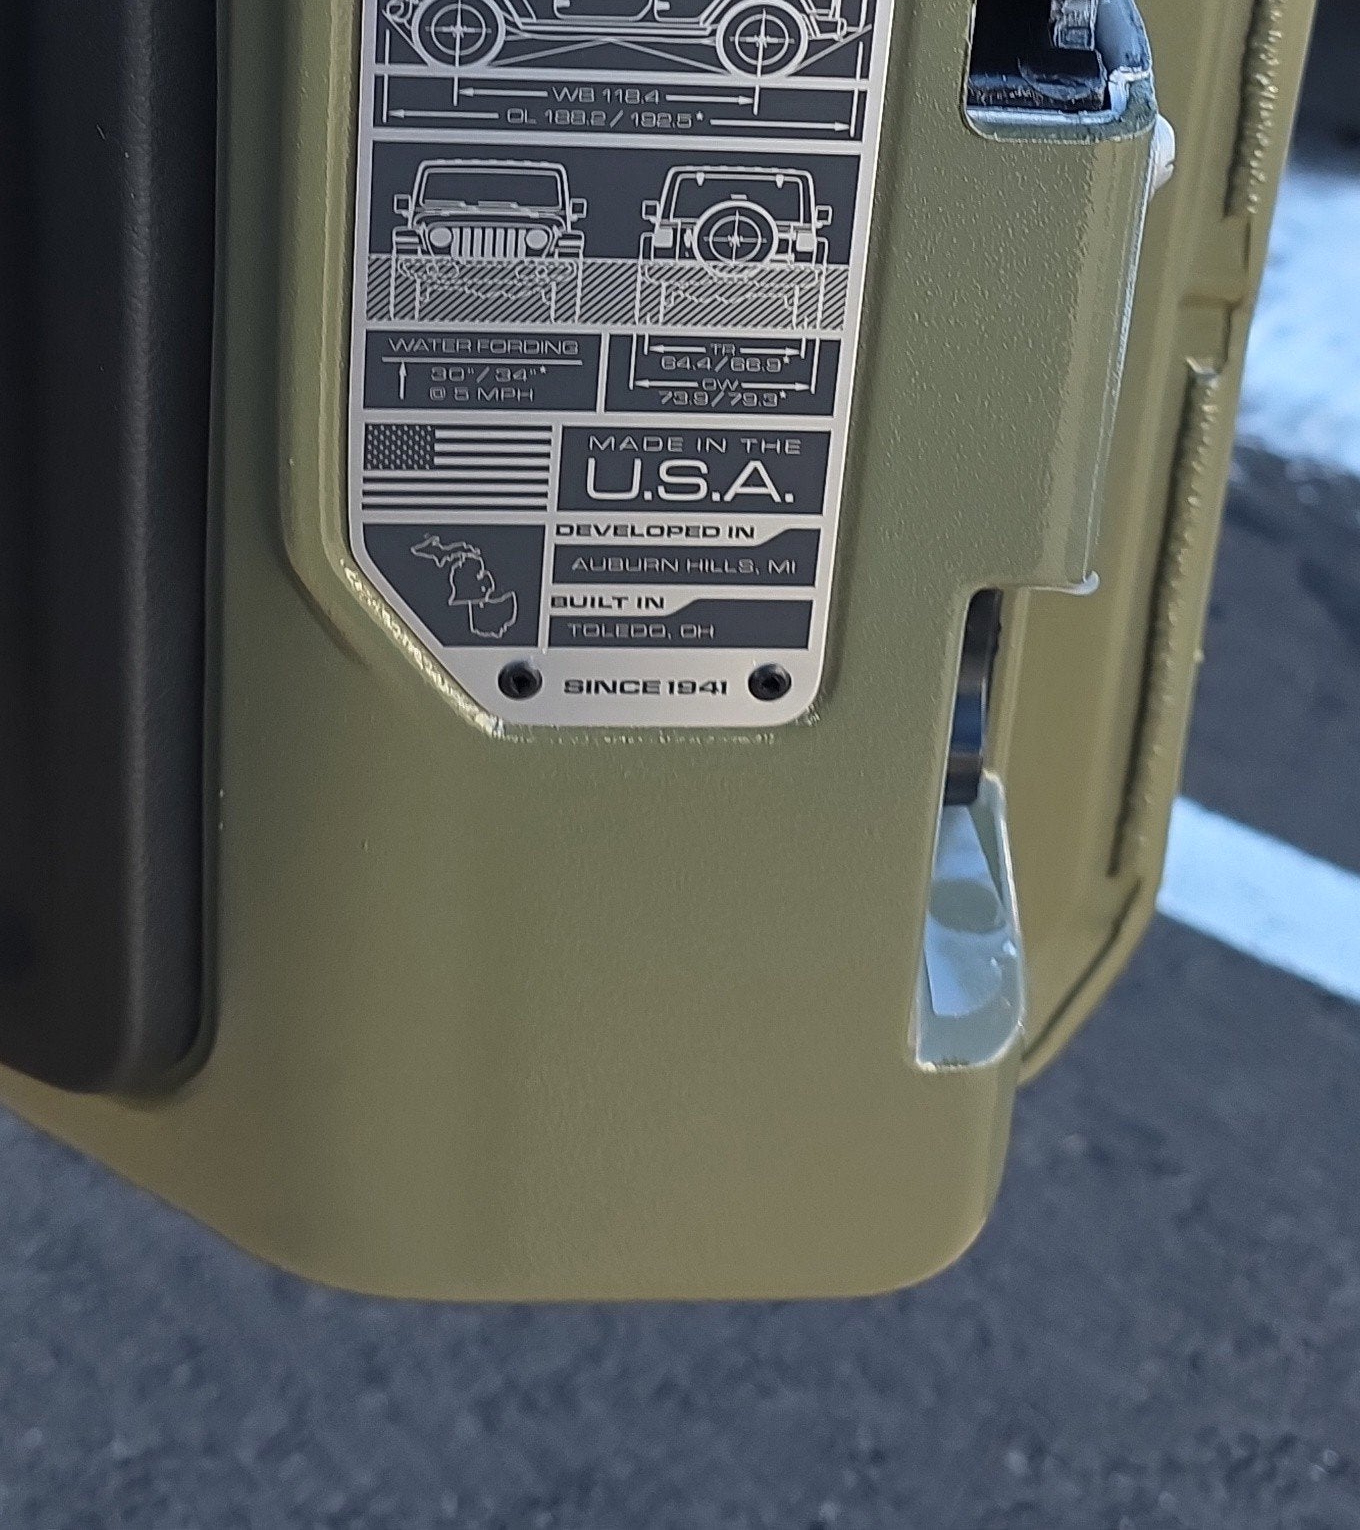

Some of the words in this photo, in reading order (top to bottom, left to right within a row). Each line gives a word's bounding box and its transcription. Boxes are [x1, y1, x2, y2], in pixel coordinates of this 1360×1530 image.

[552, 86, 595, 103] WB
[602, 88, 659, 105] 118.4
[507, 107, 537, 125] OL
[389, 337, 472, 354] WATER
[477, 338, 579, 355] FORDING
[702, 377, 739, 392] OW
[477, 386, 534, 402] MPH
[589, 435, 684, 453] MADE
[697, 437, 727, 454] IN
[740, 437, 802, 455] THE
[586, 457, 794, 504] U.S.A.
[555, 523, 721, 539] DEVELOPED
[728, 524, 756, 539] IN
[571, 556, 680, 573] AUBURN
[686, 557, 760, 575] HILLS,
[768, 558, 796, 574] MI
[550, 595, 629, 609] BUILT
[636, 596, 665, 609] IN
[568, 622, 672, 640] TOLEDO,
[680, 623, 715, 639] OH
[563, 678, 662, 695] SINCE
[668, 679, 728, 695] 1941
